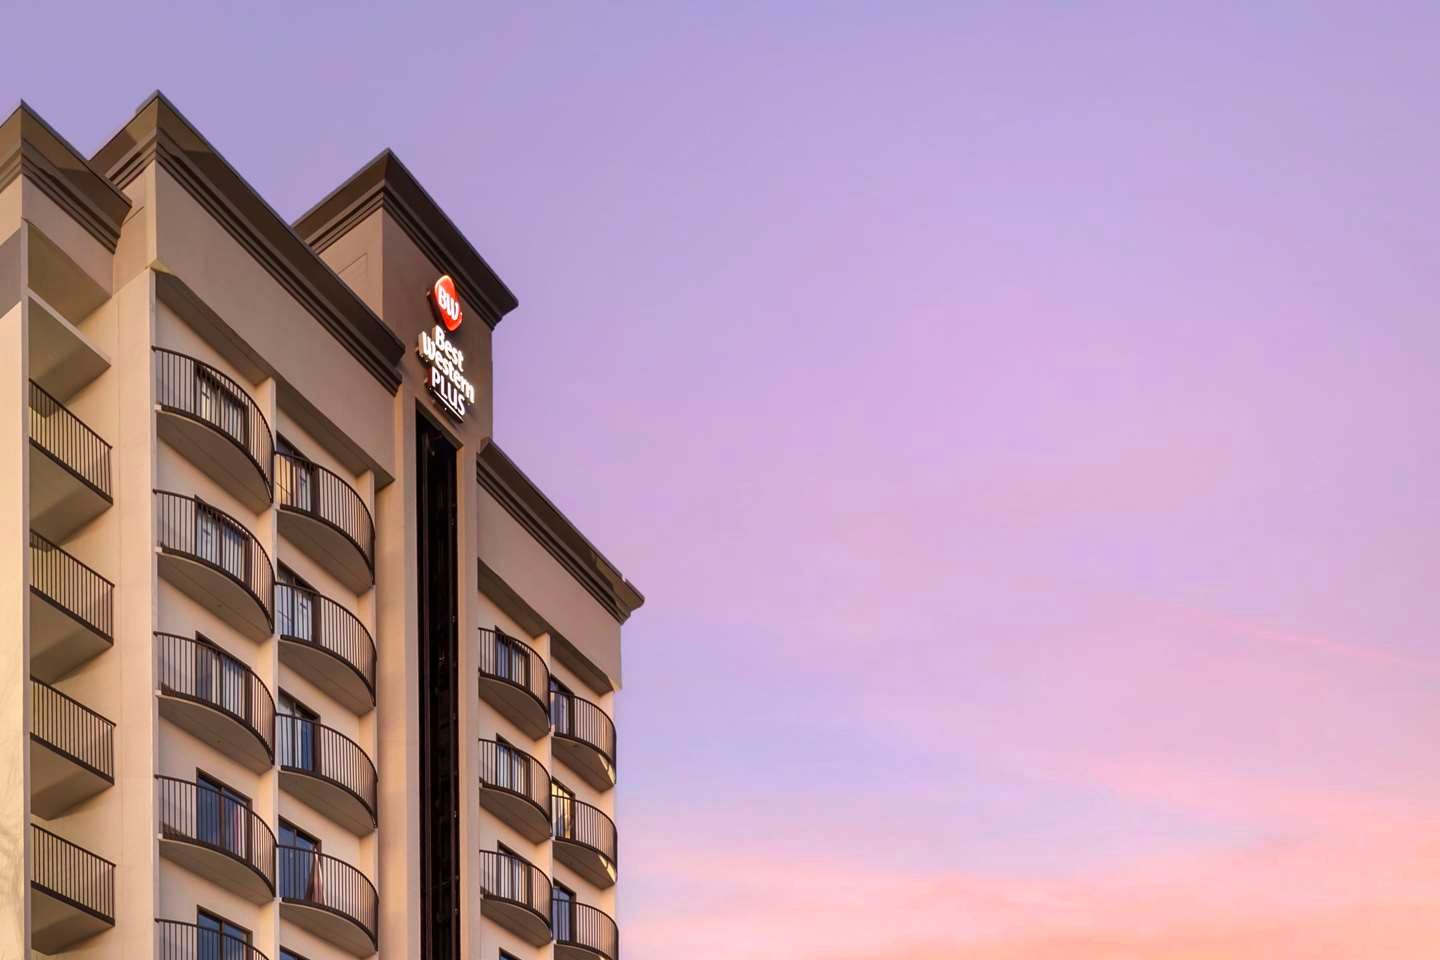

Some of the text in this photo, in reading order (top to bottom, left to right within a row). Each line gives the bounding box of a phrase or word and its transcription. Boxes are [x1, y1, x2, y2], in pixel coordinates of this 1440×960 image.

[437, 285, 460, 321] BW
[419, 331, 475, 404] Western
[433, 325, 464, 373] Best
[432, 366, 465, 416] PLUS
